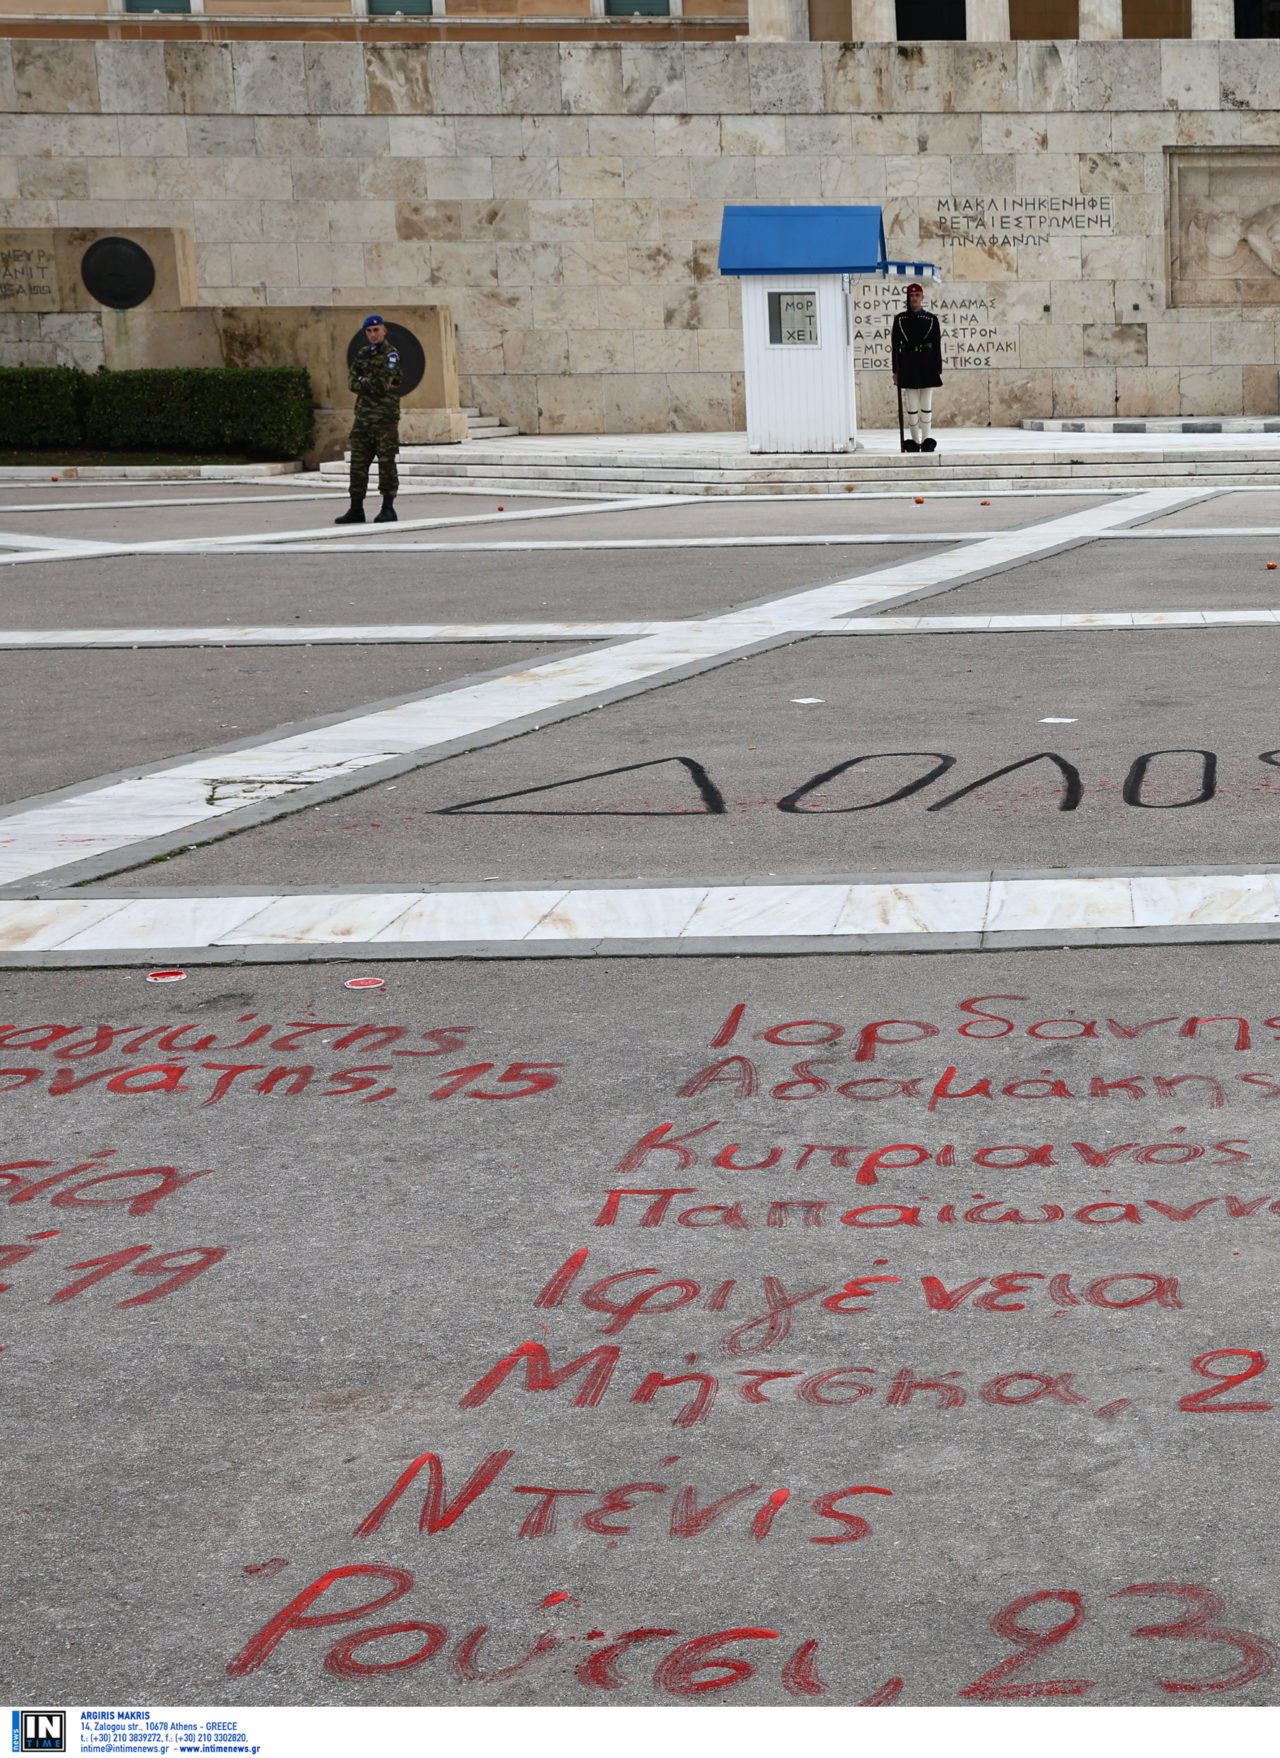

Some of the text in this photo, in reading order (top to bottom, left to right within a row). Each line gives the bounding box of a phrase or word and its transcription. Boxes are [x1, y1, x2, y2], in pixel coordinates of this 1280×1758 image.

[0, 1012, 475, 1060] αγιώτης
[428, 1062, 566, 1100] 15
[50, 1243, 232, 1311] 19
